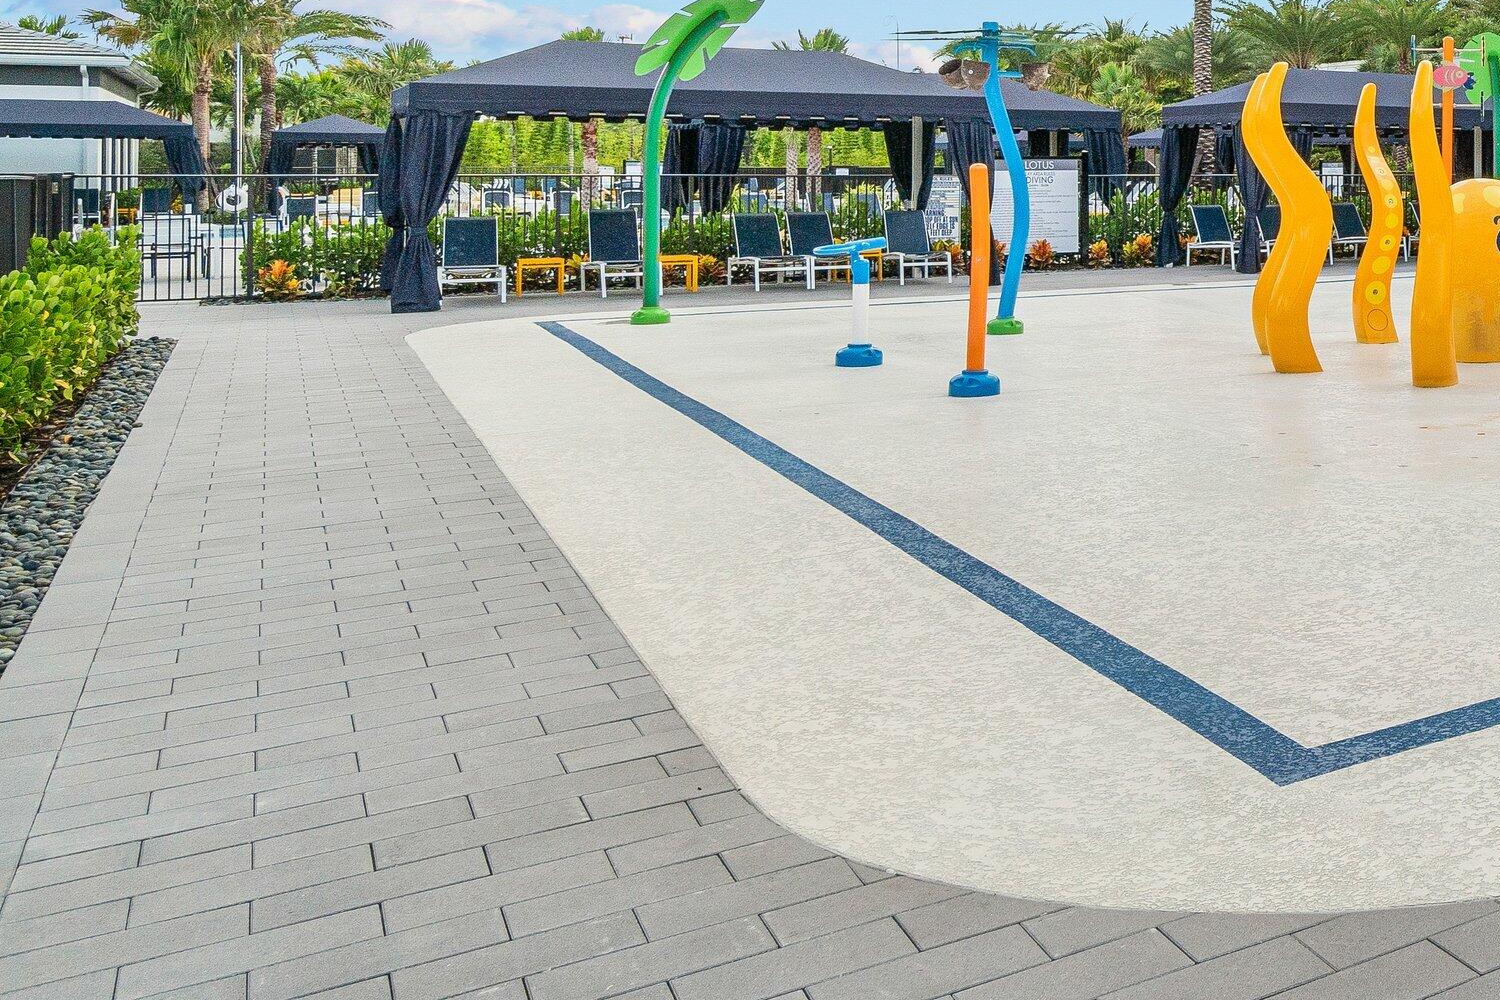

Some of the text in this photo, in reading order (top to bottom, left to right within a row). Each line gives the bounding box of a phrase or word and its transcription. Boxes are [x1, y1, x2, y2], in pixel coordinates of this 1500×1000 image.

[1025, 160, 1055, 169] LOTUS
[1026, 175, 1054, 184] DIVING
[925, 209, 945, 217] ARNING
